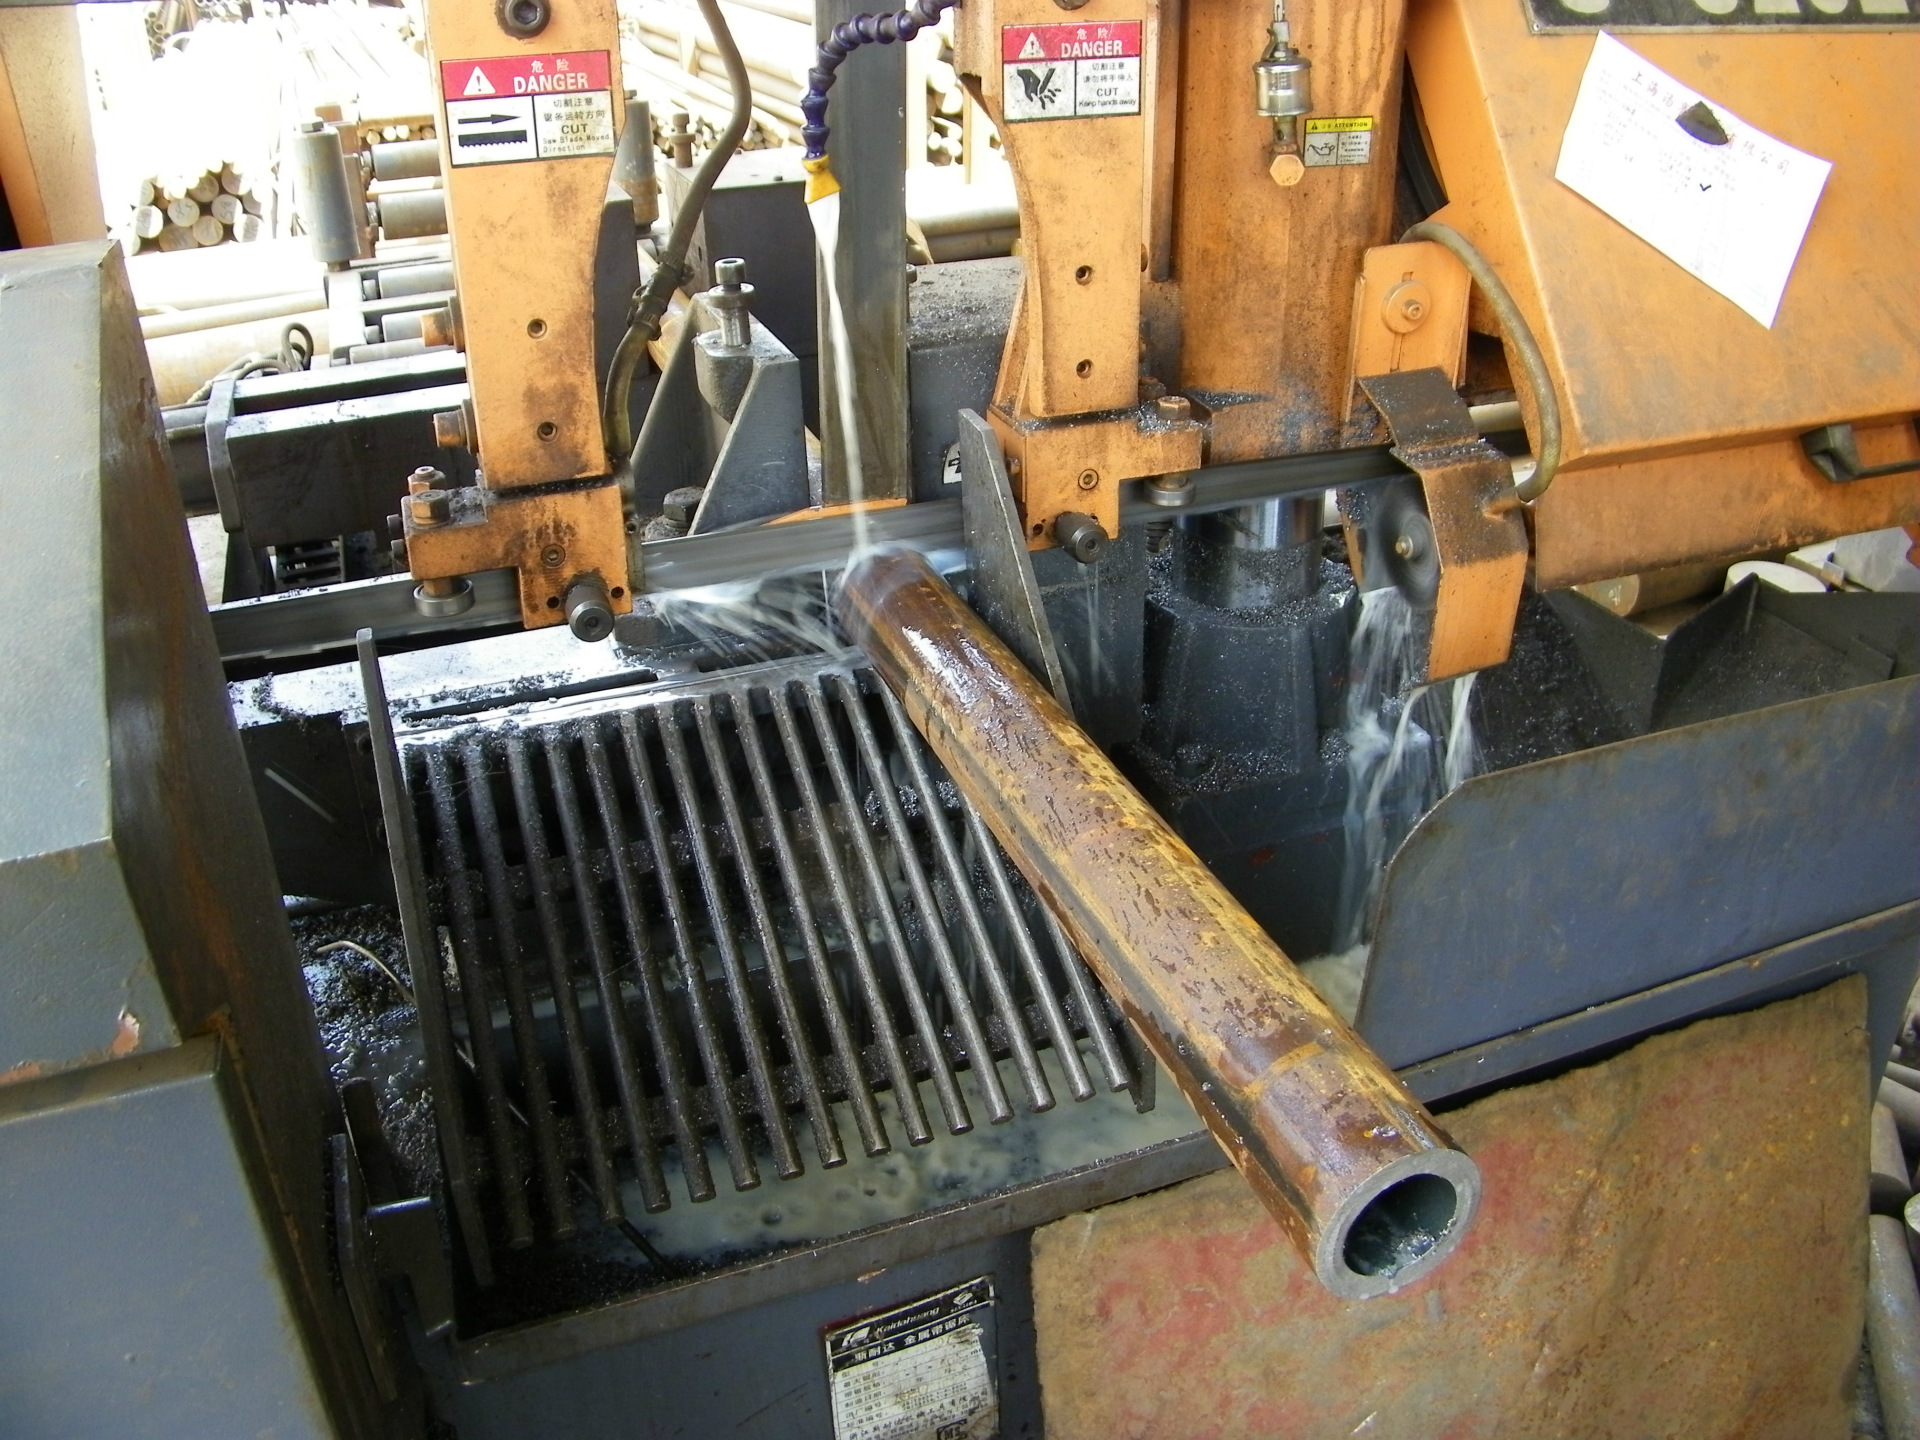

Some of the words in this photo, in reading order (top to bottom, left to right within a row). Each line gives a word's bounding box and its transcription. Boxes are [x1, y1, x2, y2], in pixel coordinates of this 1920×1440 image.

[1061, 39, 1123, 58] DANGER
[530, 58, 570, 74] 危险
[513, 72, 589, 94] DANGER
[1096, 88, 1119, 97] CUT
[553, 97, 594, 107] 切割注意
[1097, 99, 1118, 107] hands
[1119, 98, 1137, 106] away
[561, 123, 588, 135] CUT
[543, 137, 557, 145] Saw
[560, 135, 584, 144] Blade
[586, 133, 610, 141] Moved
[543, 144, 586, 153] Direction
